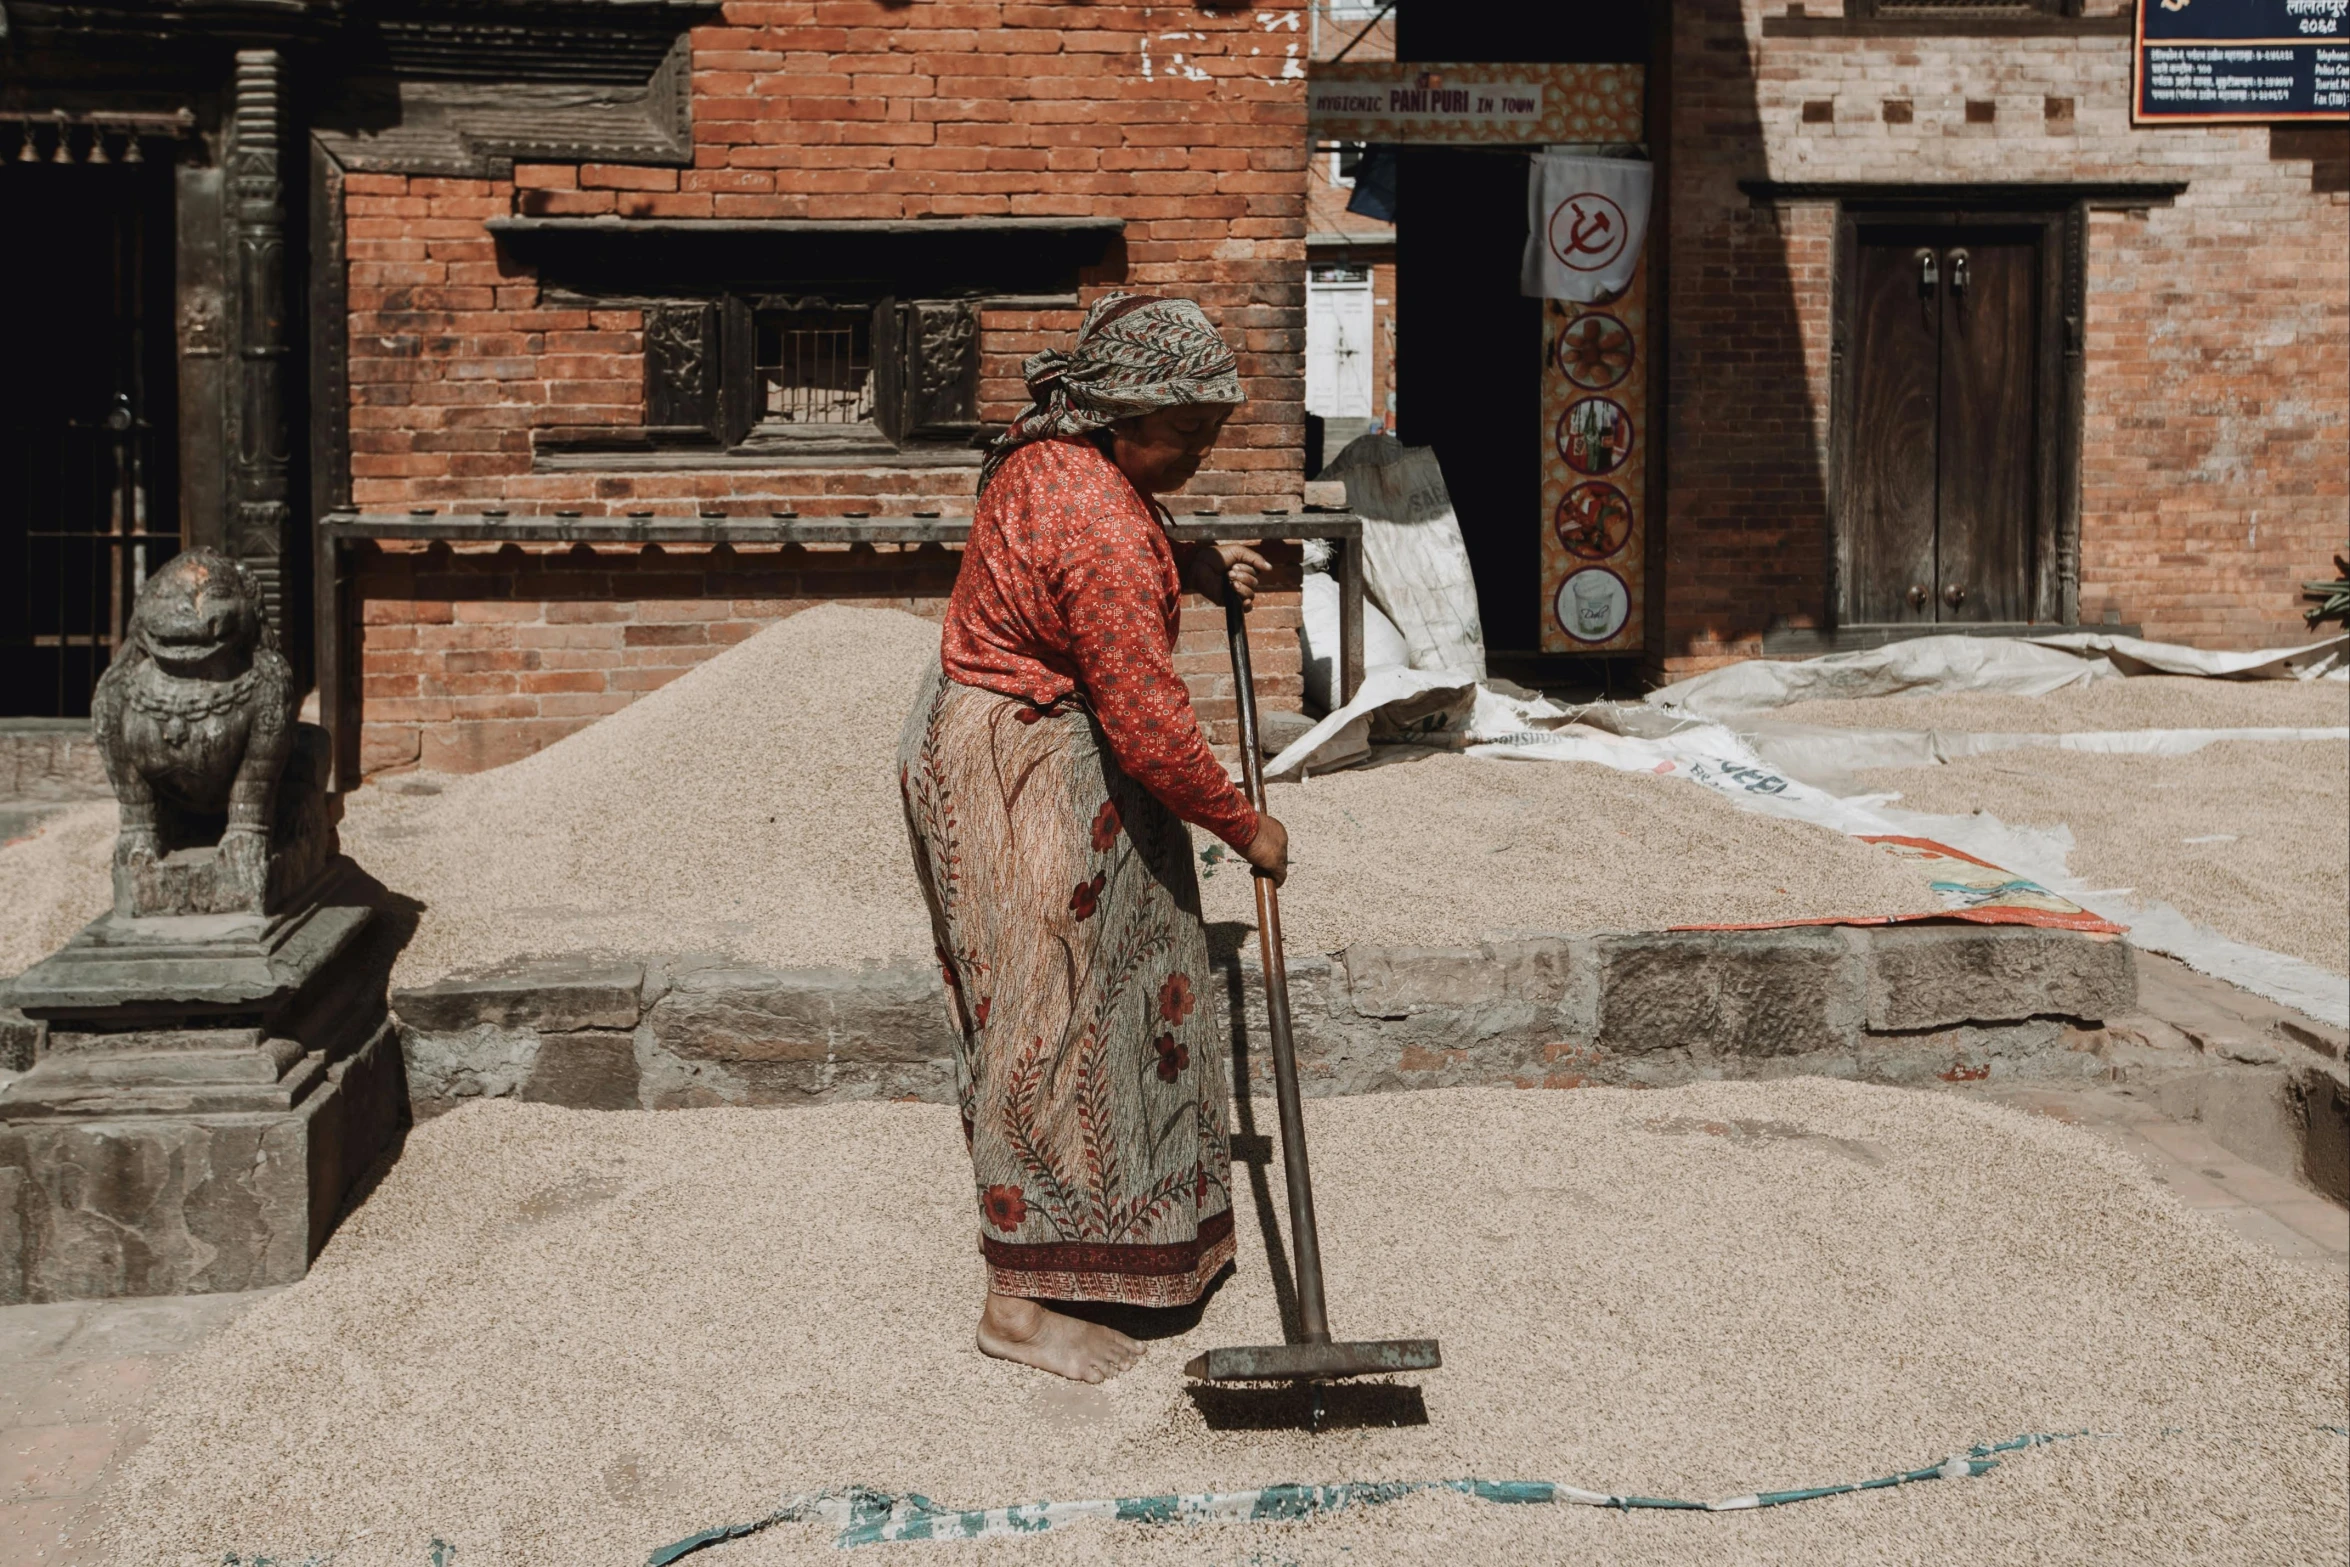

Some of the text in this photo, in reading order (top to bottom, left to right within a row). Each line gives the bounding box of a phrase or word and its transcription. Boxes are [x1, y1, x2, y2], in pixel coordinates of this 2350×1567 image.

[1316, 90, 1535, 113] HYGIENIC PANI PURI IN TOWN
